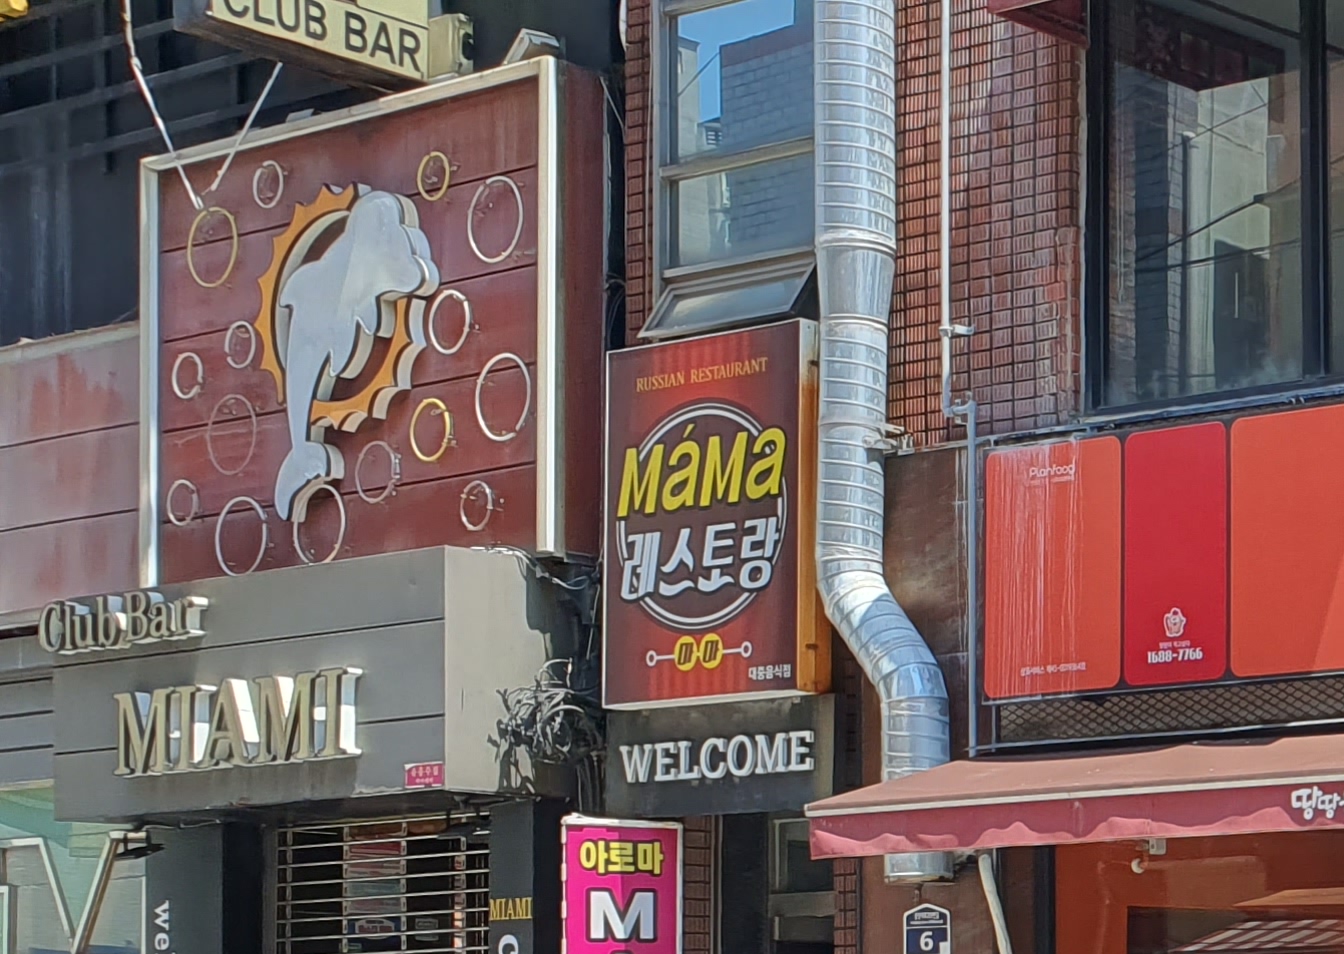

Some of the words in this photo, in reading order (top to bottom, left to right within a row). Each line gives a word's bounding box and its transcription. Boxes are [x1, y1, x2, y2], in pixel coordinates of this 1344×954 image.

[345, 10, 424, 73] BAR
[636, 371, 685, 392] RUSSIAN
[690, 357, 768, 384] RESTAURANT
[620, 516, 780, 600] 레스토랑
[39, 596, 120, 652] Club
[124, 590, 204, 641] Bar
[748, 664, 791, 681] 대중음식점
[1147, 648, 1203, 664] 1688-7766
[113, 667, 358, 777] MIAMI
[619, 730, 814, 783] WELCOME
[579, 840, 664, 875] 아로마
[489, 897, 532, 921] MIAMI
[920, 931, 934, 951] 6
